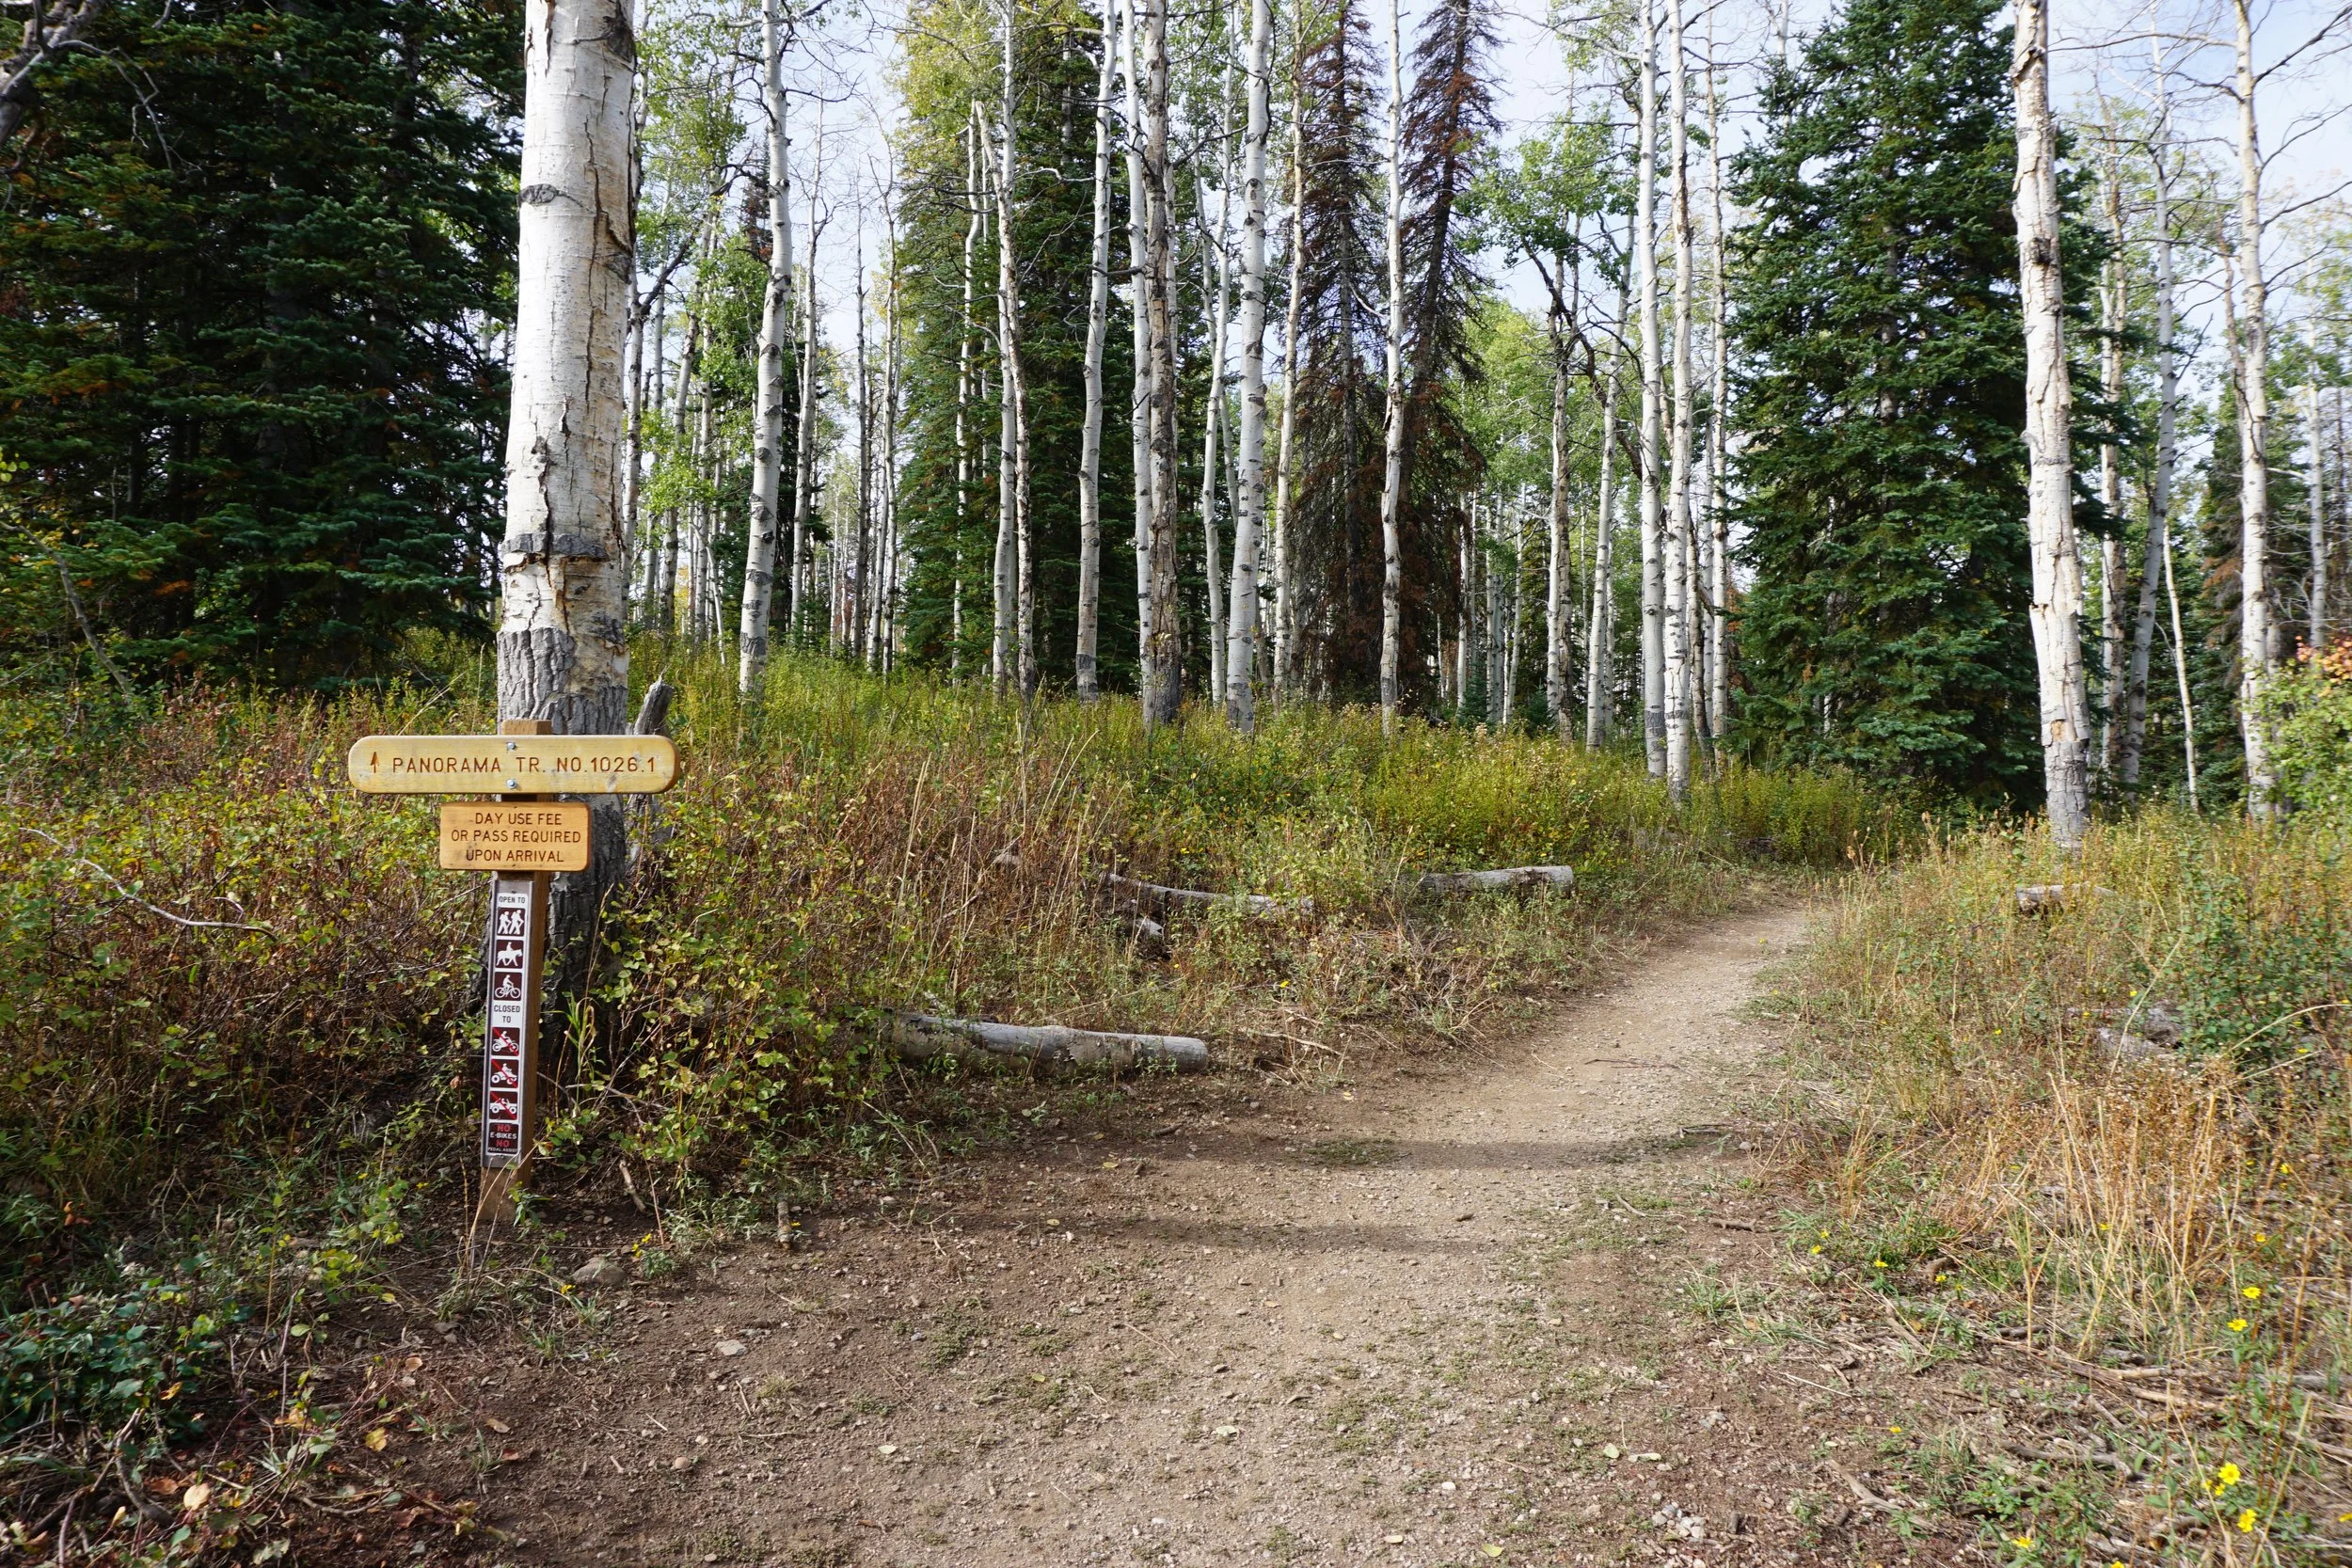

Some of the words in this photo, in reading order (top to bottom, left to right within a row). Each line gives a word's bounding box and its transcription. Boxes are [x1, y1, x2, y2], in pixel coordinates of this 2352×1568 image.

[392, 756, 501, 773] PANORAMA
[516, 756, 546, 773] TR.
[475, 813, 503, 825] DAY
[508, 813, 532, 825] USE
[538, 813, 563, 826] FEE
[451, 830, 469, 843] OR
[473, 830, 508, 843] PASS
[513, 831, 581, 844] REQUIRED
[466, 849, 501, 862] UPON
[506, 849, 564, 863] ARRIVAL
[499, 895, 516, 904] OPEN
[494, 1005, 520, 1013] CLOSED
